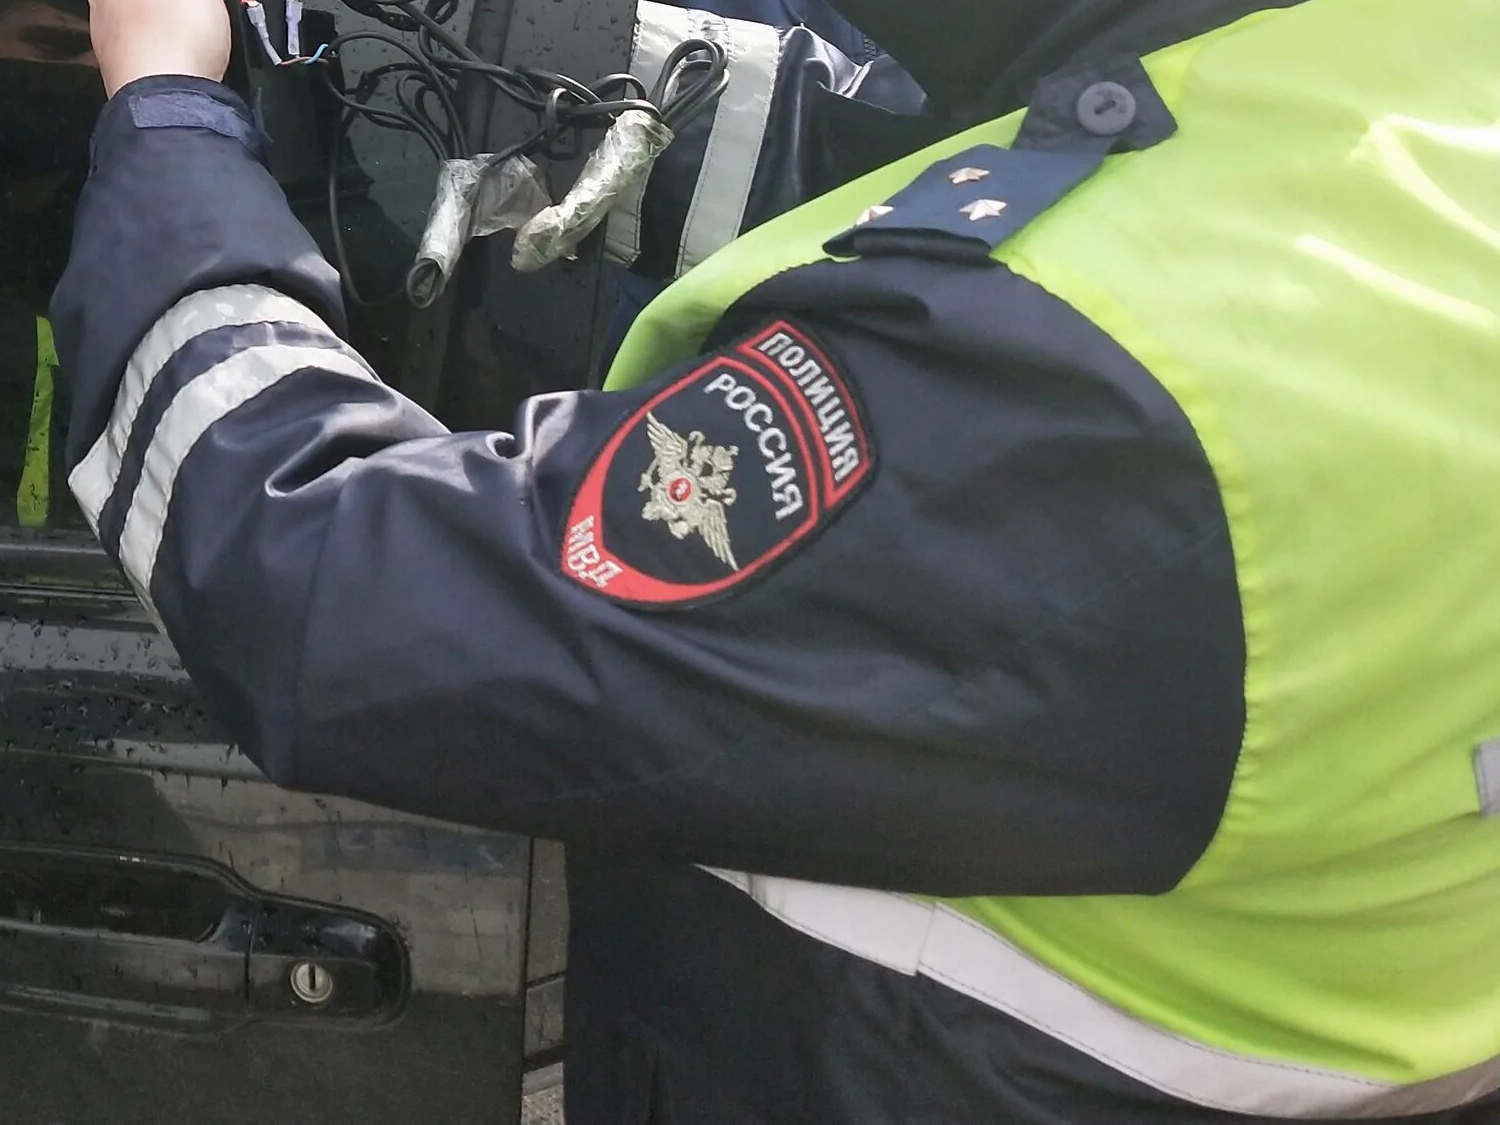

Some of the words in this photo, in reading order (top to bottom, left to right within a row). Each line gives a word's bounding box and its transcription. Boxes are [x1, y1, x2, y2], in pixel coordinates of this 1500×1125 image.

[703, 373, 804, 520] РОССИЯ
[758, 332, 860, 482] ПОЛИЦИЯ
[566, 516, 623, 588] МВД
